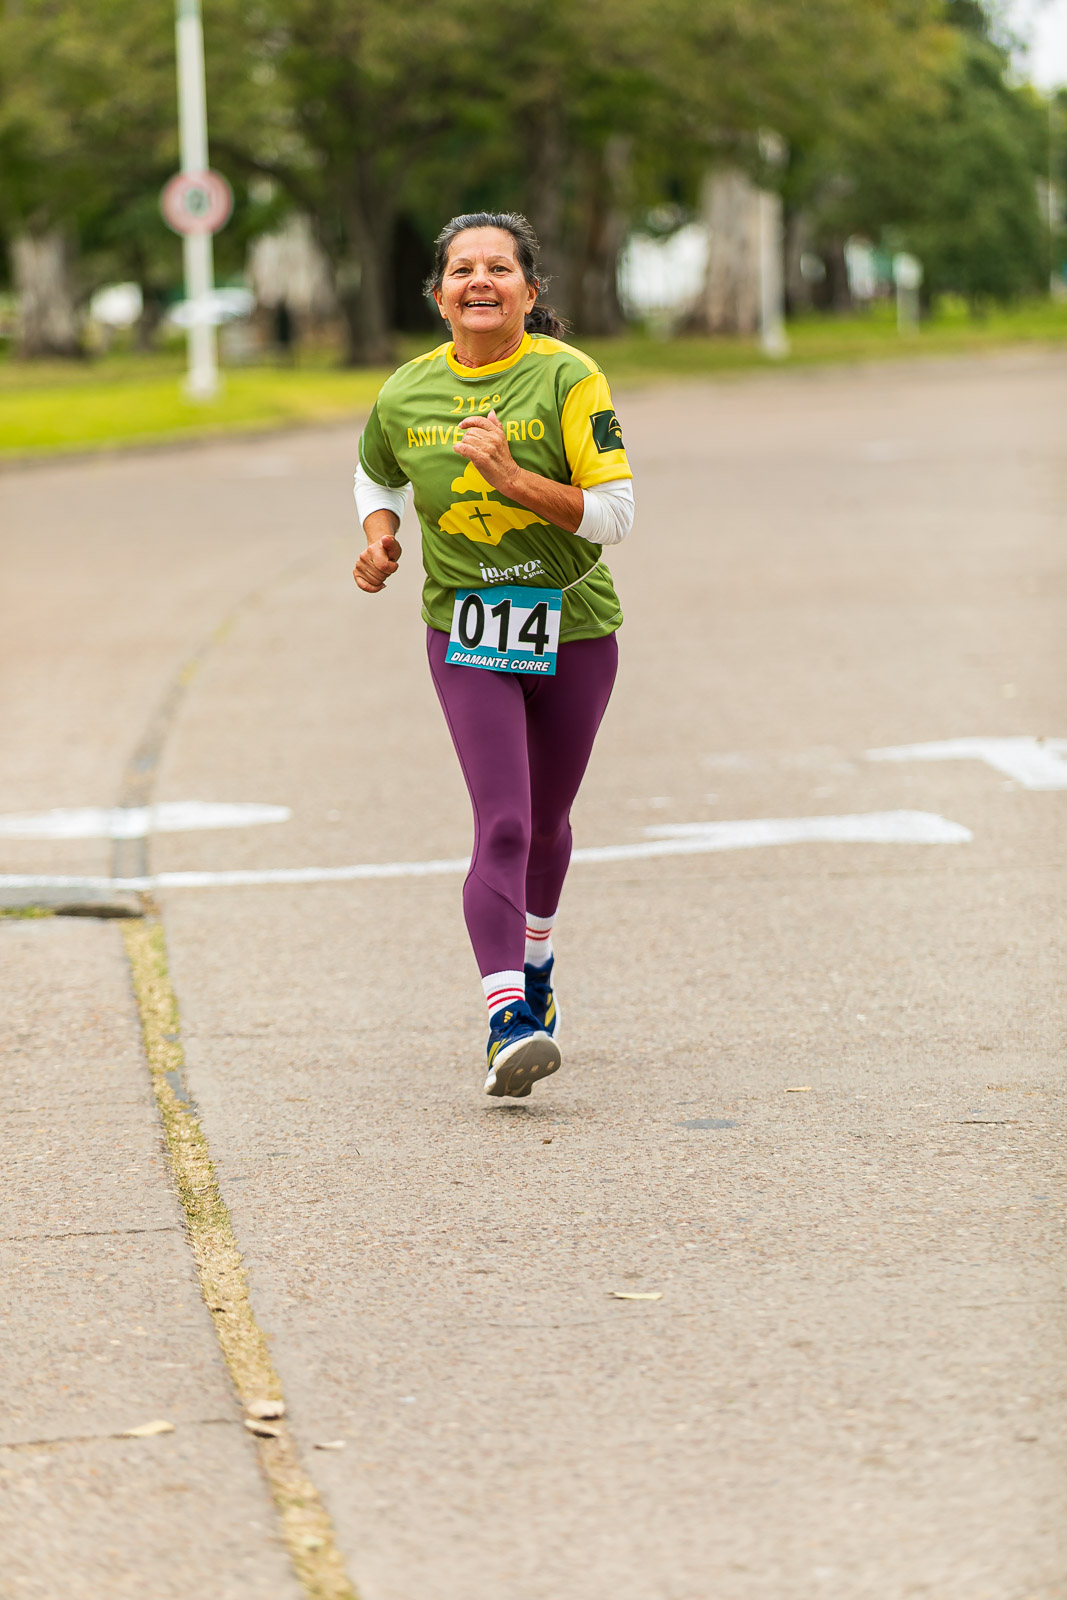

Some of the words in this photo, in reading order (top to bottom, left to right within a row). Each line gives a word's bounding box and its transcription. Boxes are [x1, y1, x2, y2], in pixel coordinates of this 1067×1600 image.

[407, 418, 545, 448] ANIVERIO
[458, 593, 550, 656] 014
[450, 651, 509, 669] DIAMANTE
[510, 659, 550, 672] CORRE
